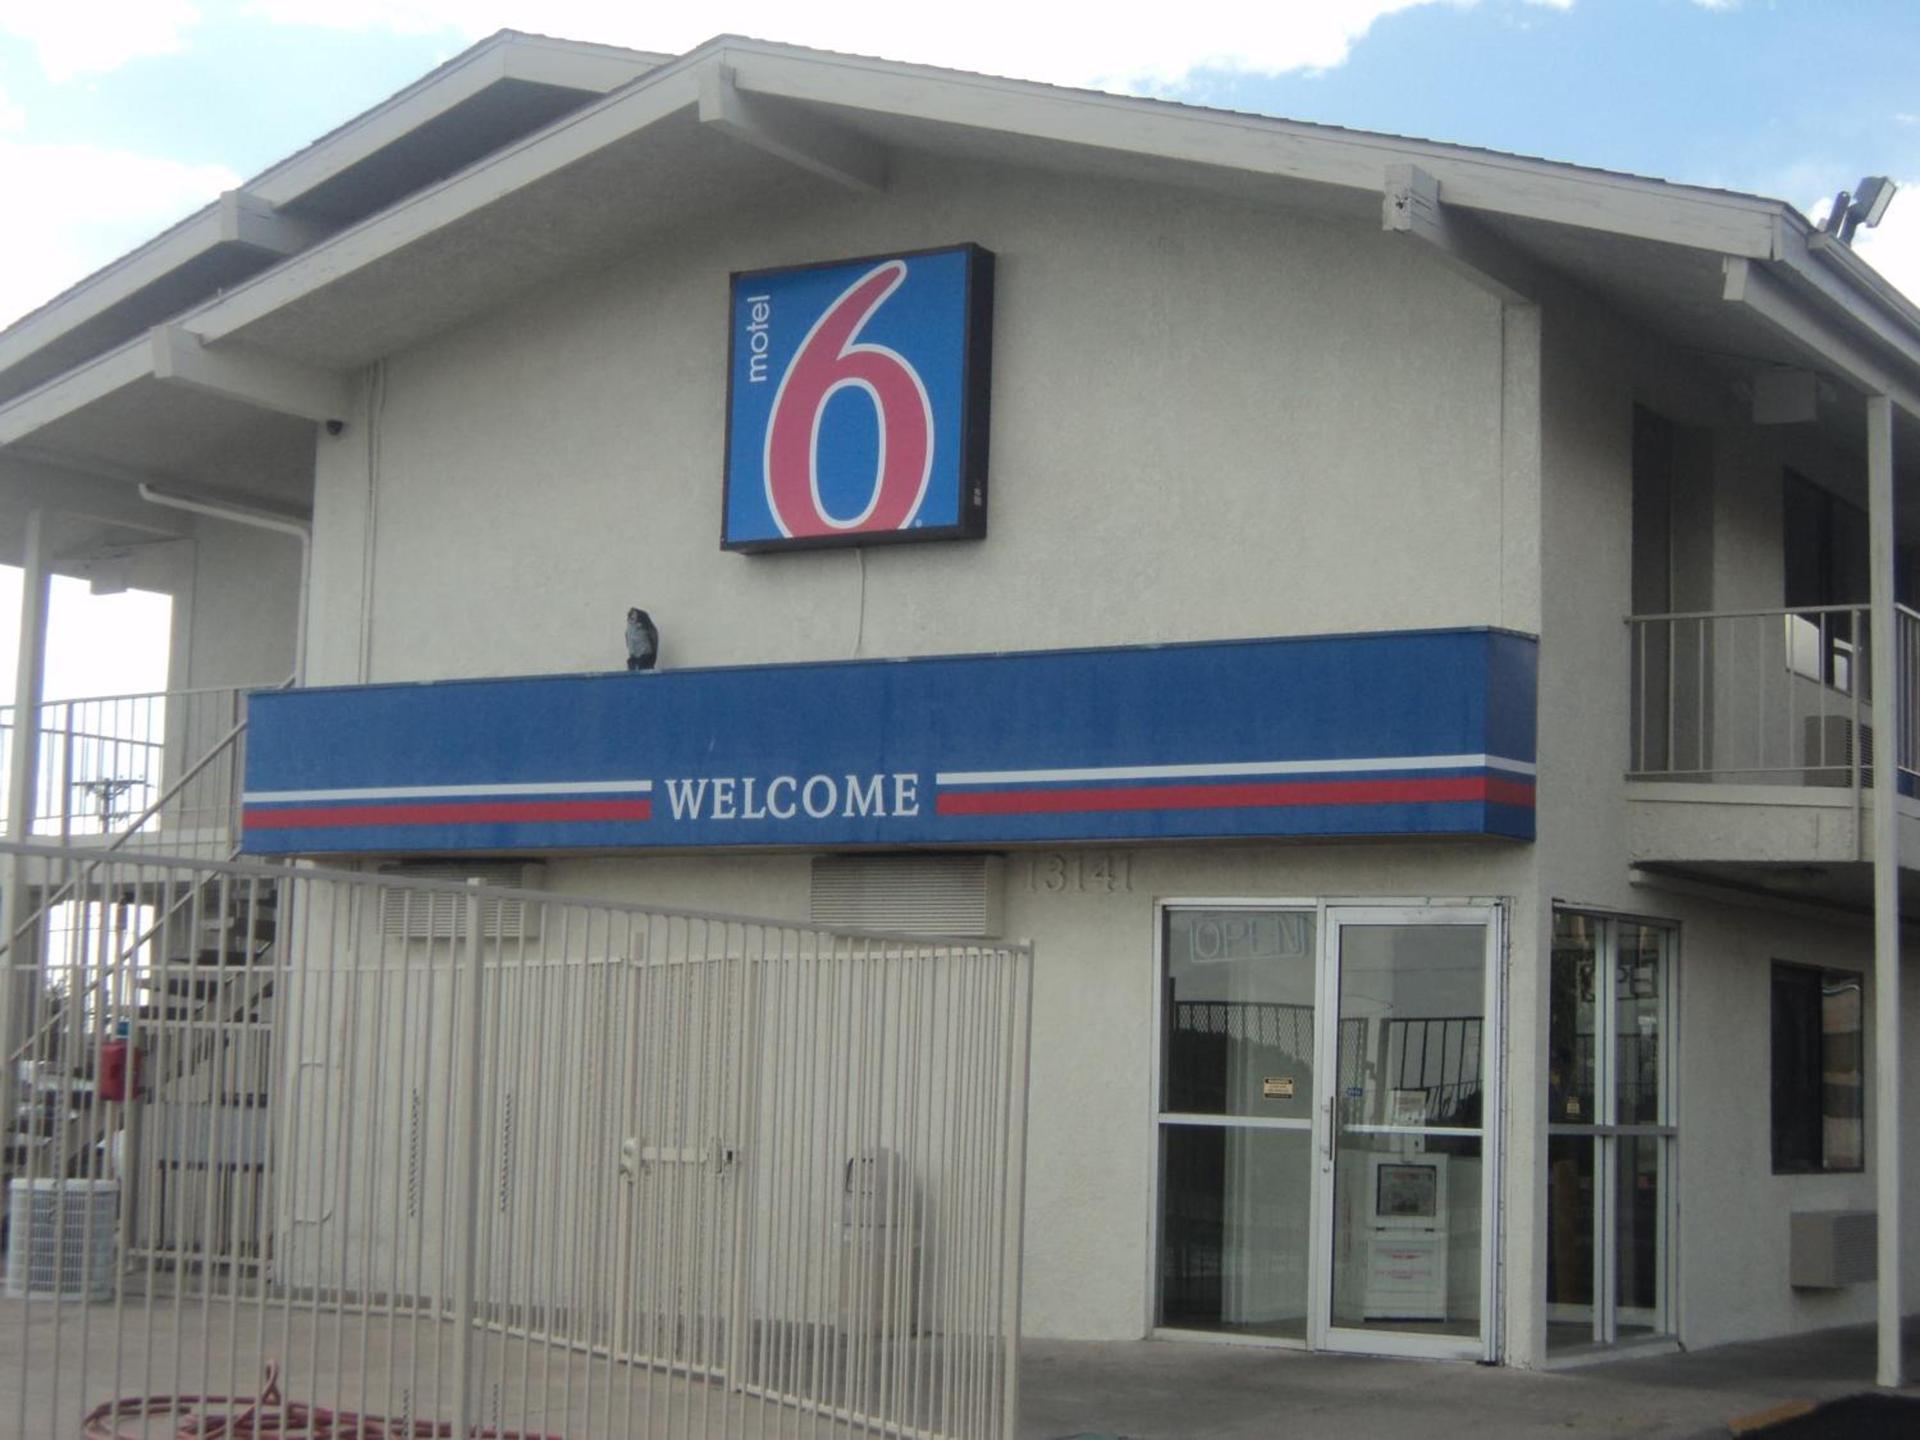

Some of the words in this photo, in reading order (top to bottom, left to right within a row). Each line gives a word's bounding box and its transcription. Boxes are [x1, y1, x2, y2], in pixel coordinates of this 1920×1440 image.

[747, 294, 770, 383] motel
[763, 259, 935, 538] 6
[665, 773, 920, 821] WELCOME
[1025, 853, 1135, 892] 13141
